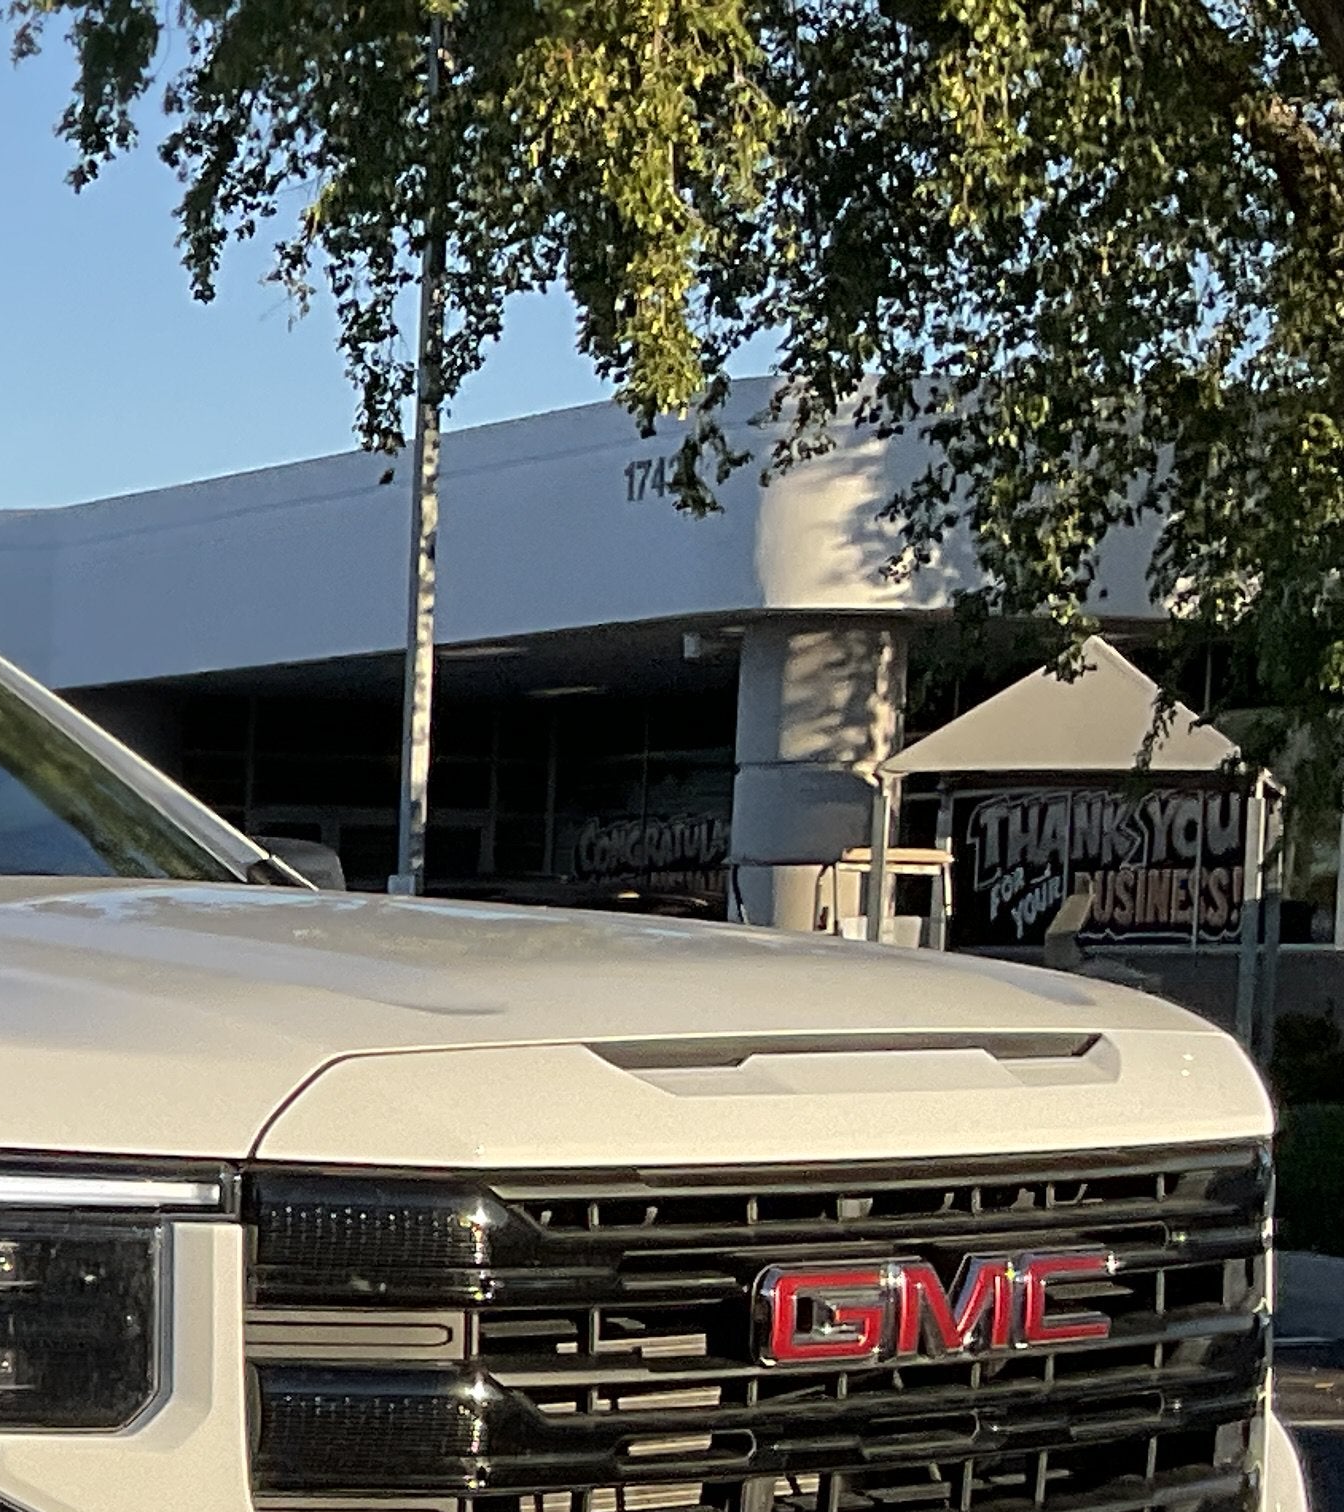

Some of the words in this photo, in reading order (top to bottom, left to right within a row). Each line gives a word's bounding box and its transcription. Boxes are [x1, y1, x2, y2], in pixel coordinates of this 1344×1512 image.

[979, 798, 1139, 868] THANK
[1144, 792, 1241, 862] YOU
[990, 866, 1025, 922] FOR
[1011, 875, 1062, 940] YOUR
[752, 1245, 1115, 1367] GMC
